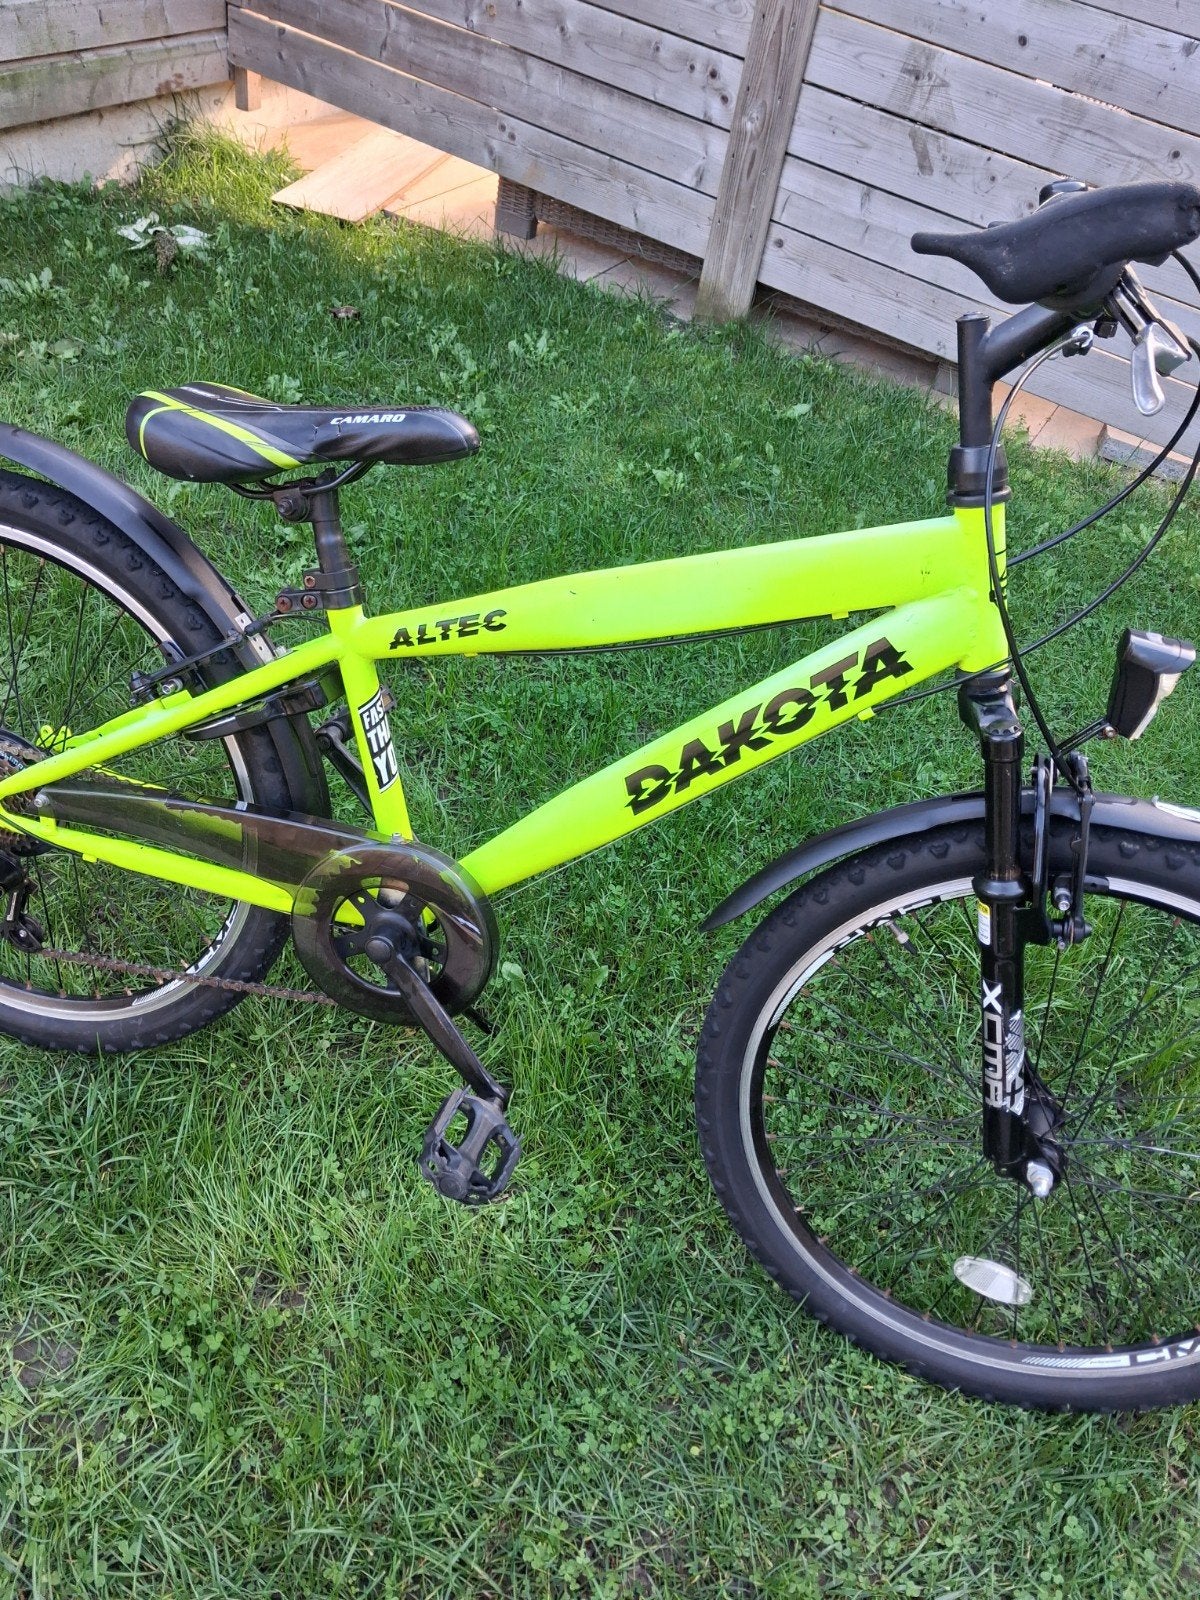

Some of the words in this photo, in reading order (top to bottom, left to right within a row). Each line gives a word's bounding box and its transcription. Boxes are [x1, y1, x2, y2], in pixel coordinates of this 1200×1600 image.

[330, 414, 405, 425] CAMARO
[389, 609, 508, 650] ALTEC
[363, 700, 384, 730] FAS
[624, 636, 914, 816] DAKOTA
[373, 742, 398, 785] YO
